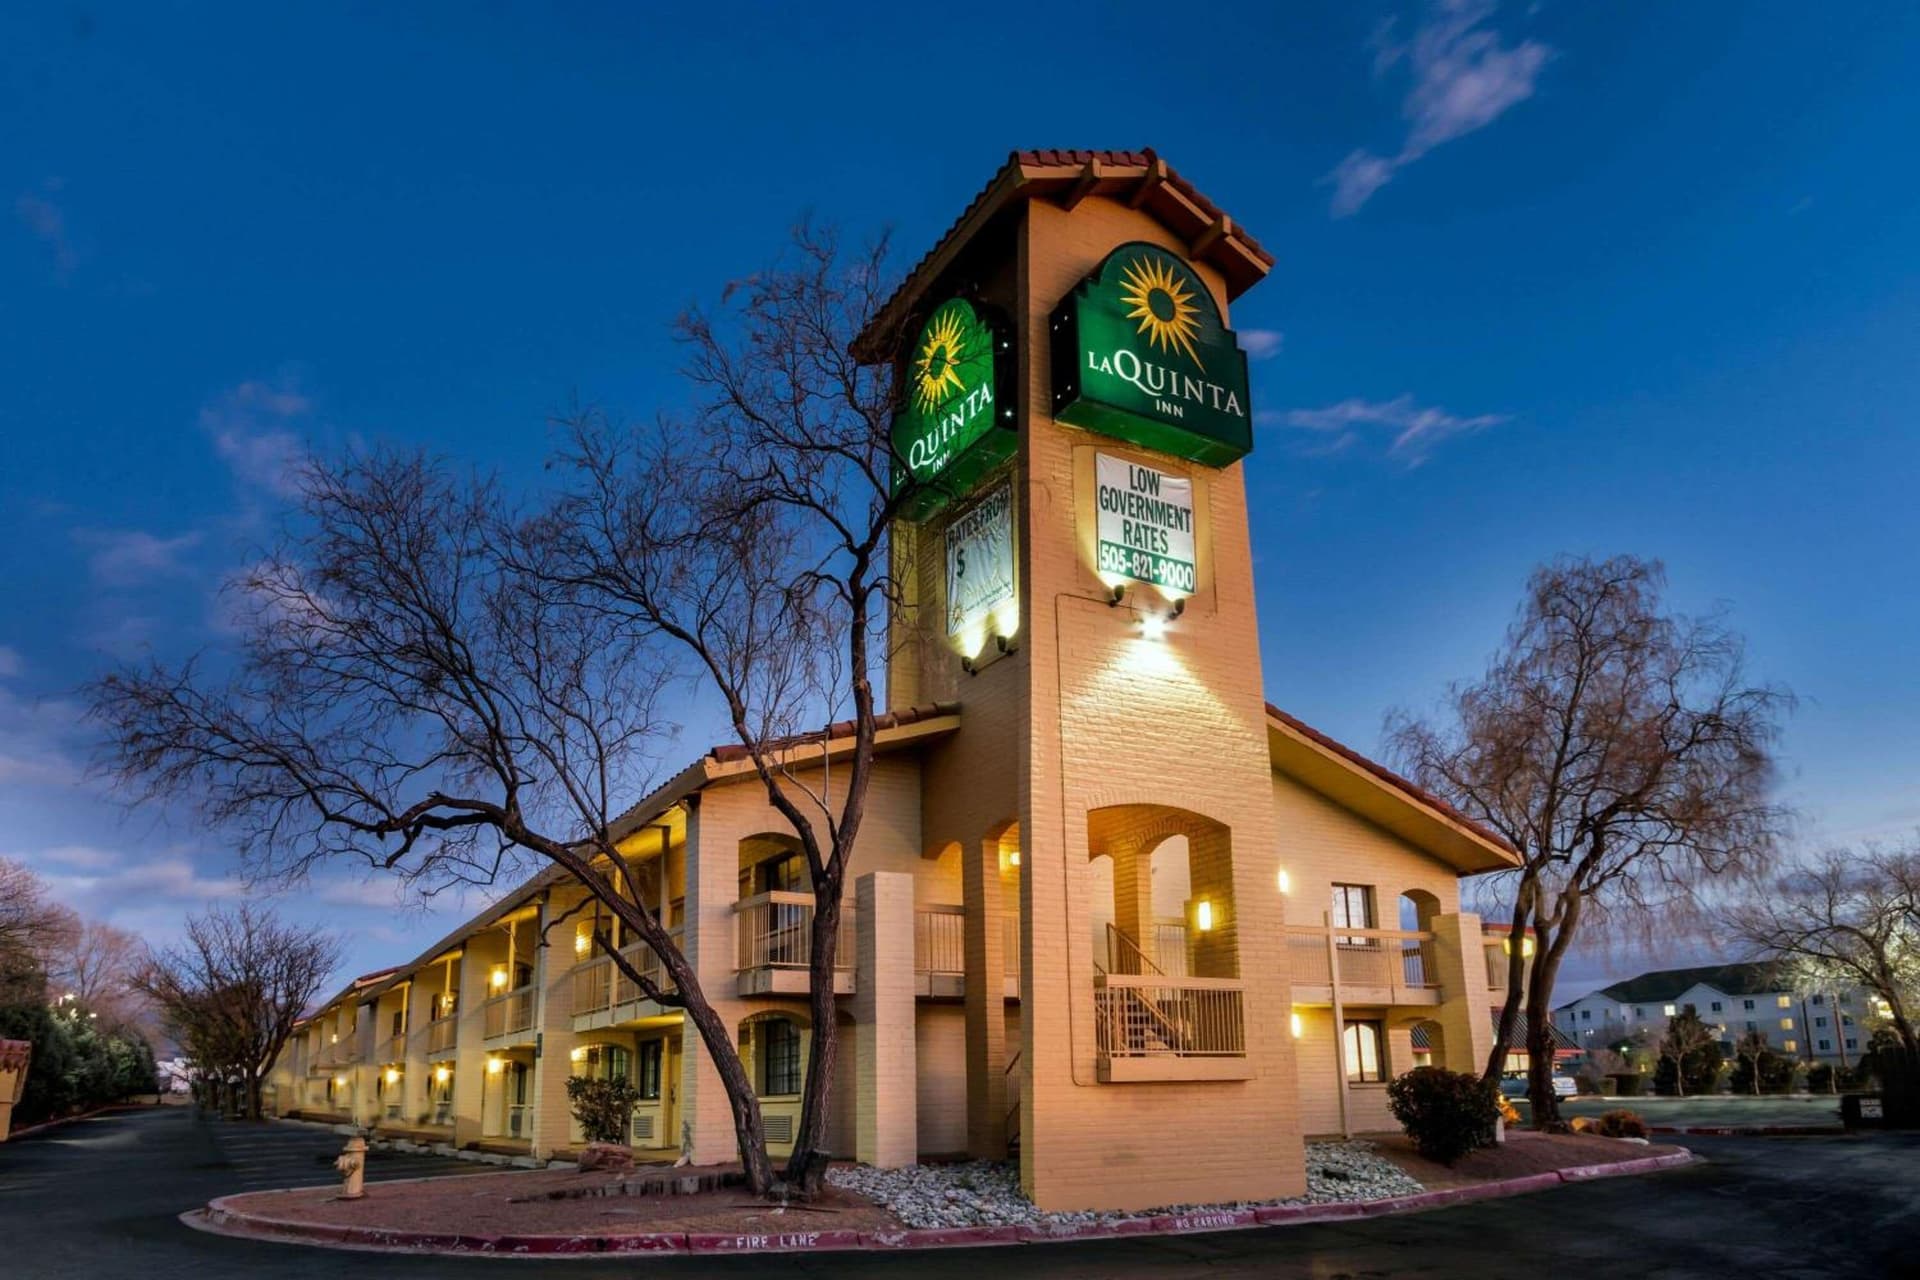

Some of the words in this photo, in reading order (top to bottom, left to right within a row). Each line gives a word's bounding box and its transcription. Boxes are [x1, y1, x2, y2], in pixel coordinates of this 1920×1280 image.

[1088, 351, 1114, 375] LA
[1113, 349, 1244, 417] QUINTA
[909, 381, 993, 470] QUINTA
[1156, 399, 1184, 418] INN
[1129, 465, 1160, 496] LOW
[1099, 485, 1191, 533] GOVERNMENT
[1123, 519, 1169, 555] RATES
[1101, 543, 1194, 591] 505-821-9000
[736, 1236, 768, 1248] FIRE
[780, 1234, 817, 1248] LANE
